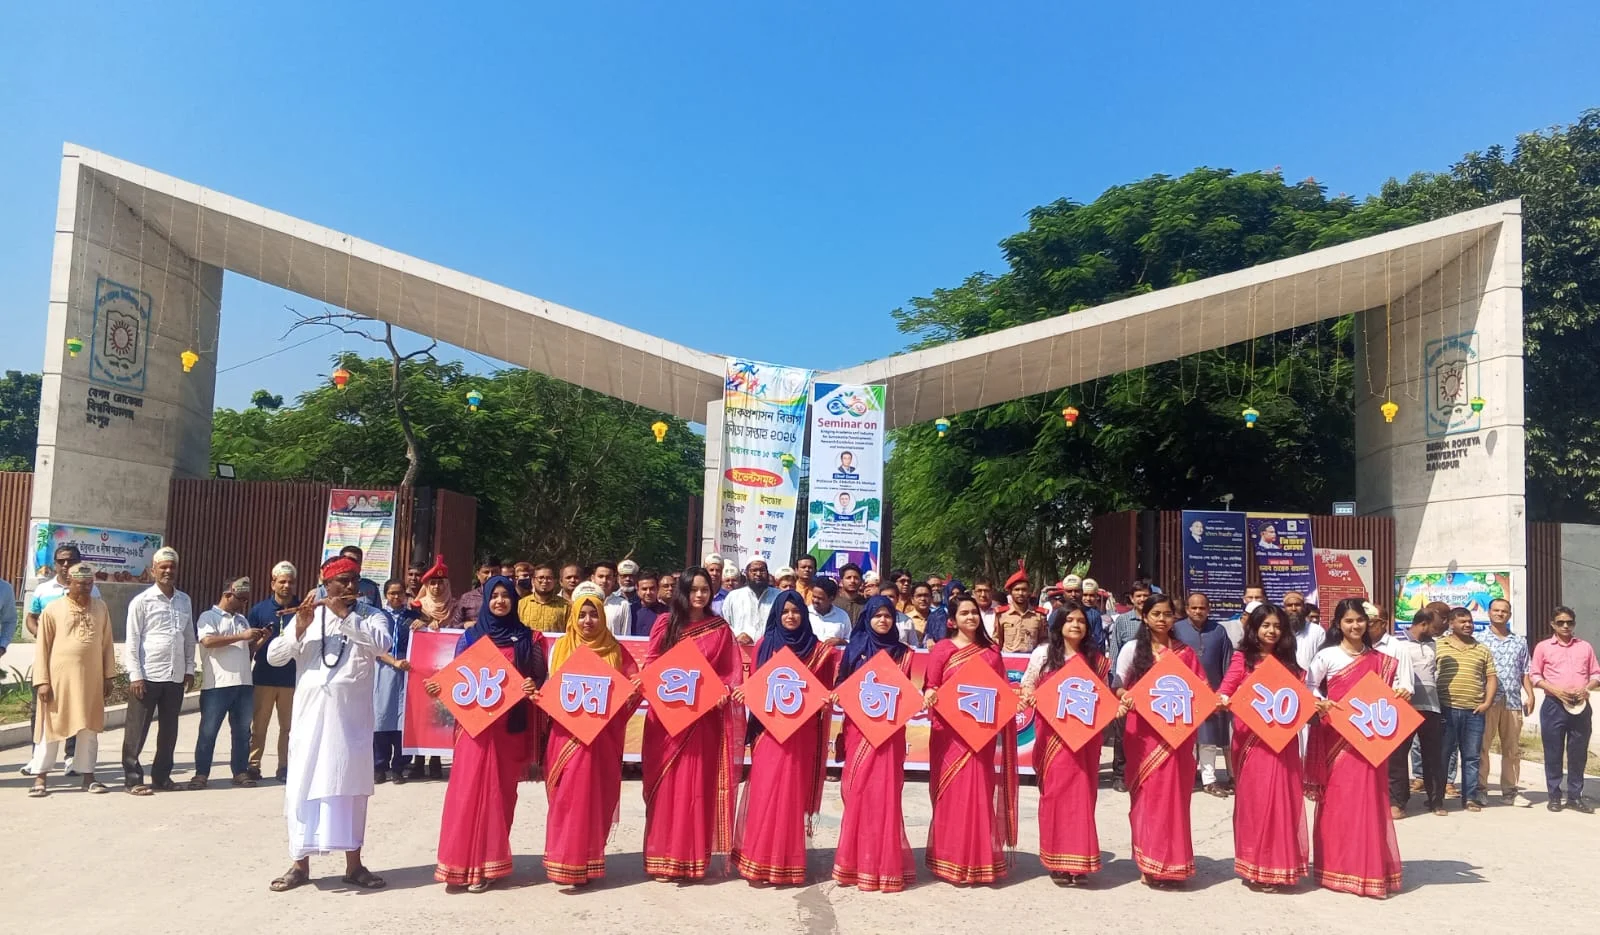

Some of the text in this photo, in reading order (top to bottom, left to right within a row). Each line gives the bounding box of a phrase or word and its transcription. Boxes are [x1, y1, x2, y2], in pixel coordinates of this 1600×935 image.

[776, 409, 802, 425] বিভাগ
[818, 417, 877, 430] Seminar on
[745, 426, 769, 440] সপ্তাহ
[770, 430, 797, 443] ২০২৬
[1426, 436, 1481, 452] BEGUM ROKEYA
[1426, 448, 1468, 461] UNIVERSITY
[1426, 460, 1460, 471] RANGPUR
[452, 664, 506, 709] ১৮
[559, 672, 612, 715] তম
[656, 667, 700, 705] প্র
[764, 667, 806, 715] তি
[957, 683, 997, 724] বা
[1149, 677, 1194, 726] কী
[1250, 682, 1299, 727] ২০
[1348, 695, 1399, 739] ২৬
